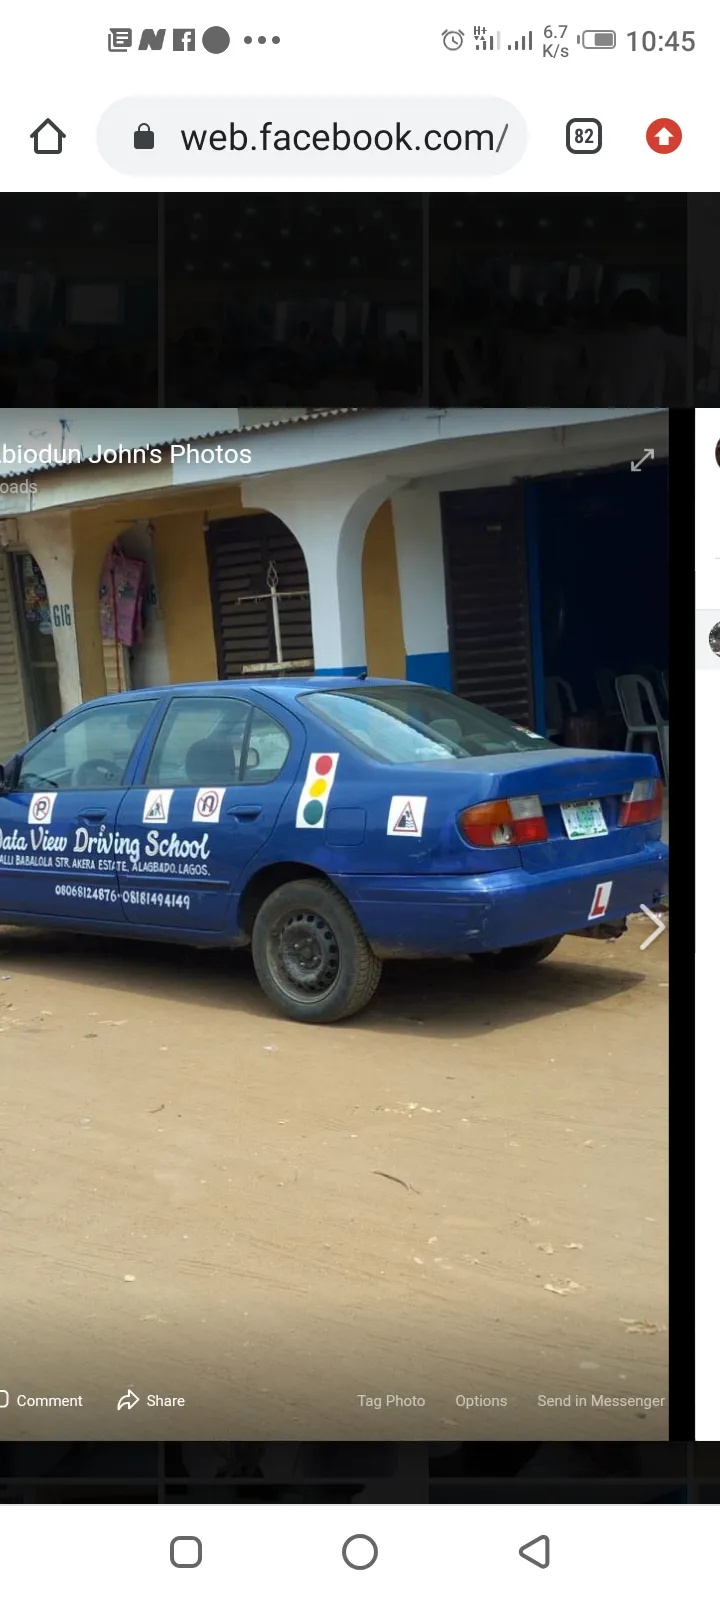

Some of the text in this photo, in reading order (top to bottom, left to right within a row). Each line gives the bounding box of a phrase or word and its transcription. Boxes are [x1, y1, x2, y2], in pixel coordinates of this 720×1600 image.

[30, 826, 68, 852] View
[73, 824, 141, 863] Driving
[145, 830, 211, 860] School
[15, 854, 53, 868] BABALOLA
[72, 858, 96, 870] AKERA
[591, 886, 605, 916] L
